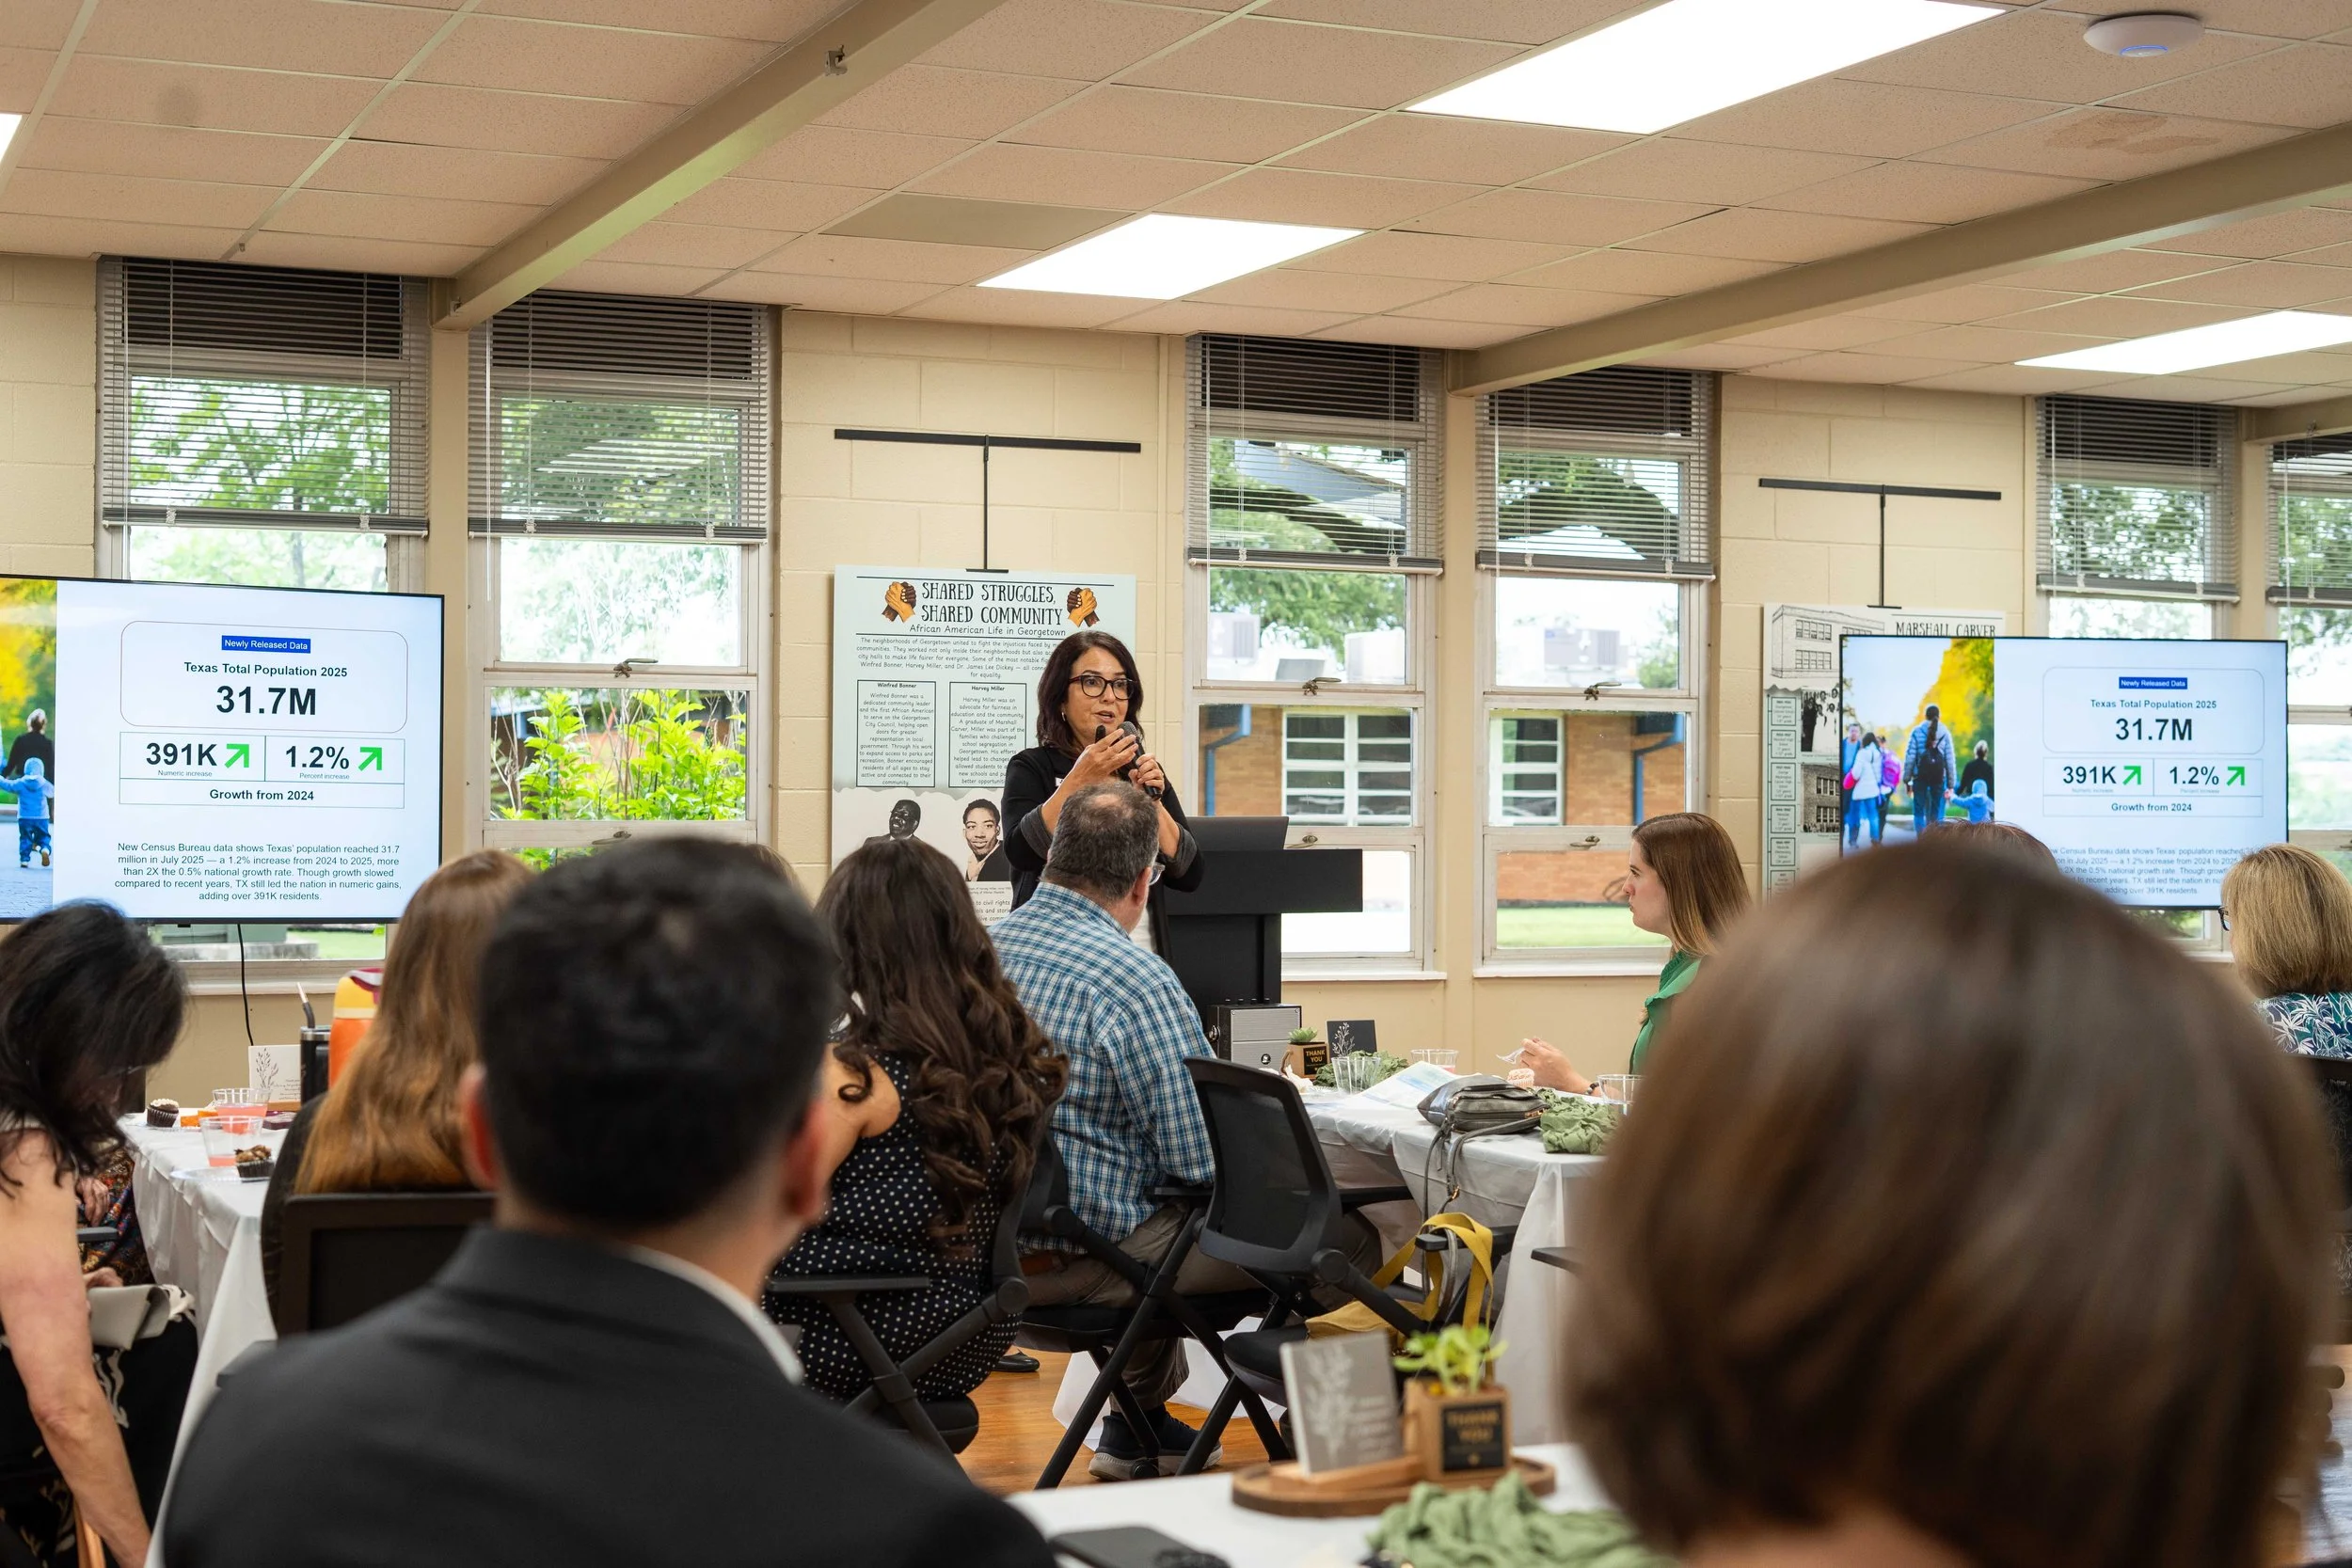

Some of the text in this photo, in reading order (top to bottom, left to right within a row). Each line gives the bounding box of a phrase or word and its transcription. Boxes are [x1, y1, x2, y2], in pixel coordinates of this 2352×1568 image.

[922, 582, 974, 600] SHARED
[921, 604, 1062, 626] SHARED COMMUNITY
[910, 624, 941, 633] African
[944, 625, 985, 634] American
[988, 626, 1003, 634] Life
[1017, 627, 1066, 638] Georgetown
[225, 639, 308, 650] Newly Released Data
[872, 637, 910, 646] neighborhoods
[919, 638, 951, 647] Georgetown
[983, 648, 1020, 656] neighborhoods
[184, 662, 348, 678] Texas Total Population 2025
[216, 685, 316, 716] 31.7M
[2090, 699, 2217, 711] Texas Total Population 2025
[2116, 718, 2192, 741] 31.7M
[146, 742, 218, 766] 391K
[286, 746, 350, 769] 1.2%
[2063, 765, 2117, 785] 391K
[2170, 766, 2219, 786] 1.2%
[209, 789, 315, 801] Growth from 2024
[2110, 802, 2192, 812] Growth from 2024
[118, 842, 139, 851] New
[141, 842, 176, 852] Census
[178, 843, 211, 852] Bureau
[213, 844, 233, 852] data
[236, 844, 264, 853] shows
[266, 844, 294, 853] Texas'
[297, 844, 341, 855] population
[381, 845, 400, 854] 31.7
[118, 855, 147, 864] million
[150, 855, 158, 864] in
[160, 855, 179, 866] July
[181, 855, 204, 864] 2025
[229, 855, 251, 864] 1.2%
[254, 856, 291, 865] increase
[293, 856, 313, 865] from
[316, 856, 337, 865] 2024
[350, 857, 375, 866] 2025,
[124, 867, 394, 879] than 2X the 0.5% national growth rate. Though growth slowed
[114, 879, 402, 890] compared to recent years, TX still led the nation in numeric gains,
[199, 891, 229, 902] adding
[254, 891, 277, 900] 391K
[280, 892, 322, 900] residents.
